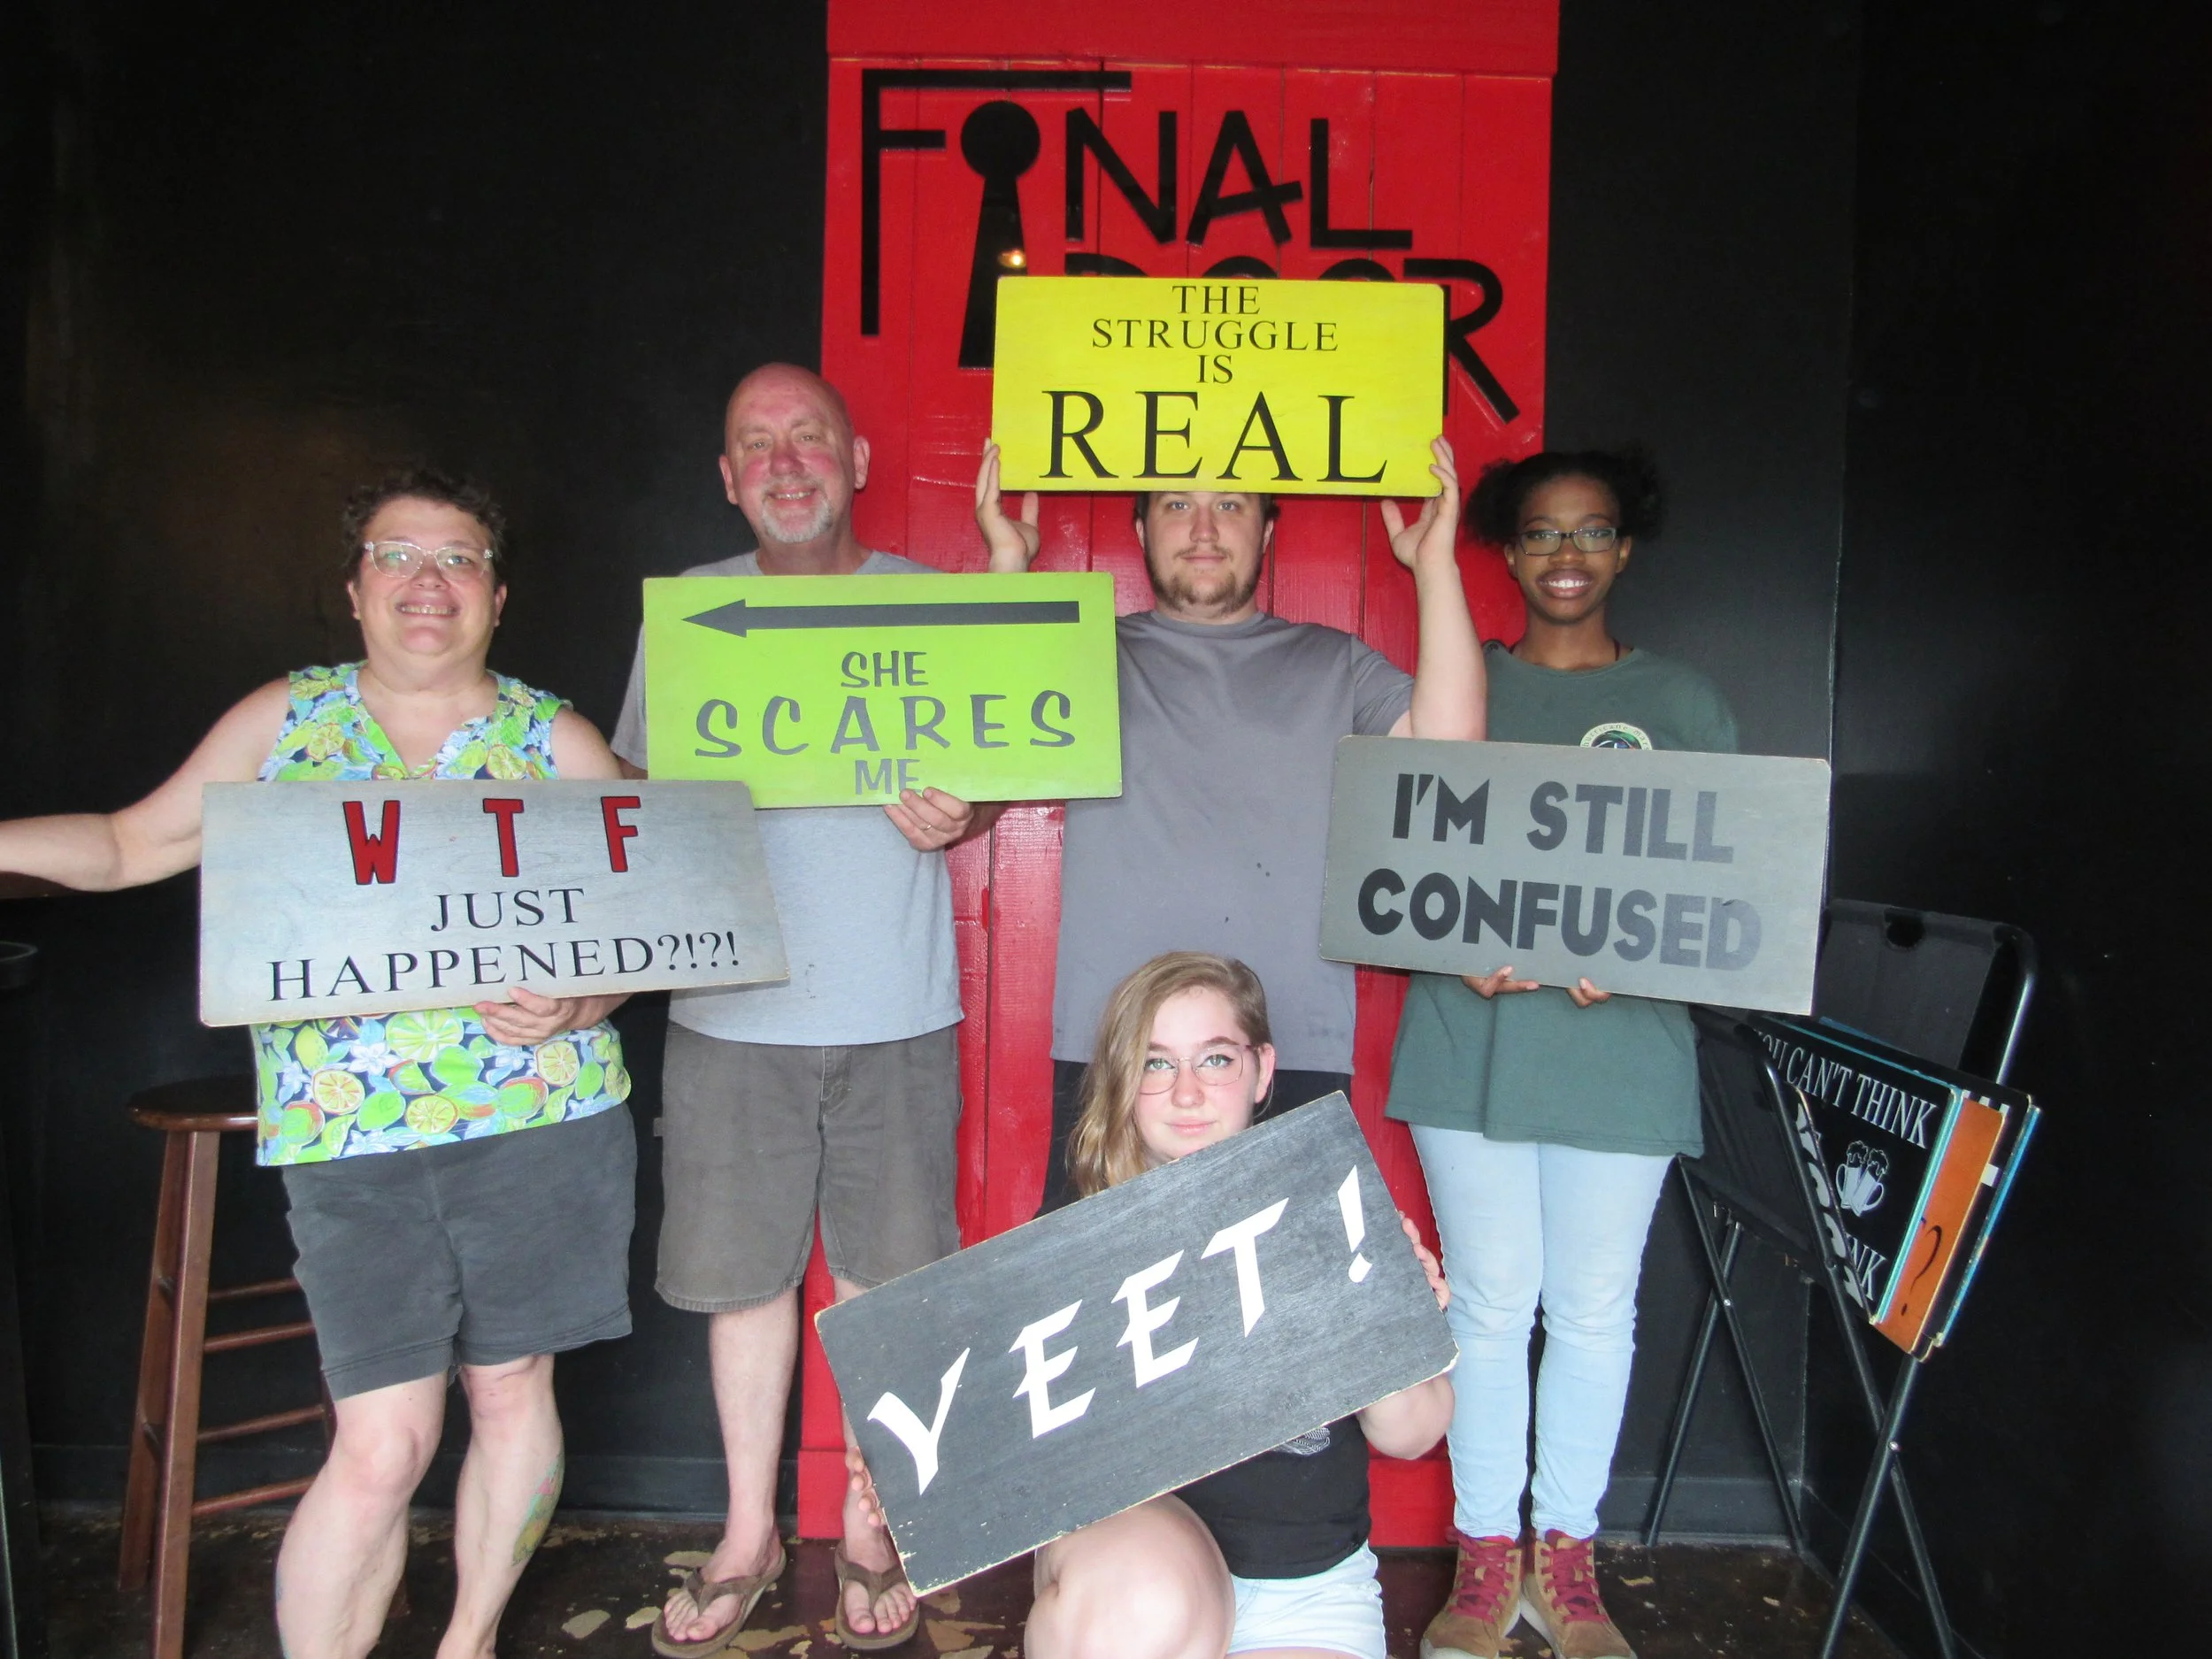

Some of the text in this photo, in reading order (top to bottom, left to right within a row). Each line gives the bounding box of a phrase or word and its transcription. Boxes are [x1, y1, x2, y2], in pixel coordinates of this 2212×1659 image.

[861, 68, 1413, 369] FINAL
[1171, 285, 1261, 315] THE
[1091, 319, 1339, 352] STRUGGLE
[1197, 354, 1233, 384] IS
[1039, 389, 1388, 484] REAL
[841, 649, 929, 689] SHE
[695, 689, 1076, 758] SCARES
[855, 758, 921, 795] ME
[1393, 772, 1734, 864] I'M STILL
[430, 887, 586, 933] JUST
[1357, 867, 1762, 972] CONFUSED
[266, 930, 741, 1002] HAPPENED?!?!
[1786, 1046, 1853, 1108] CAN'T
[1850, 1072, 1939, 1149] THINK
[866, 1164, 1374, 1497] YEET!
